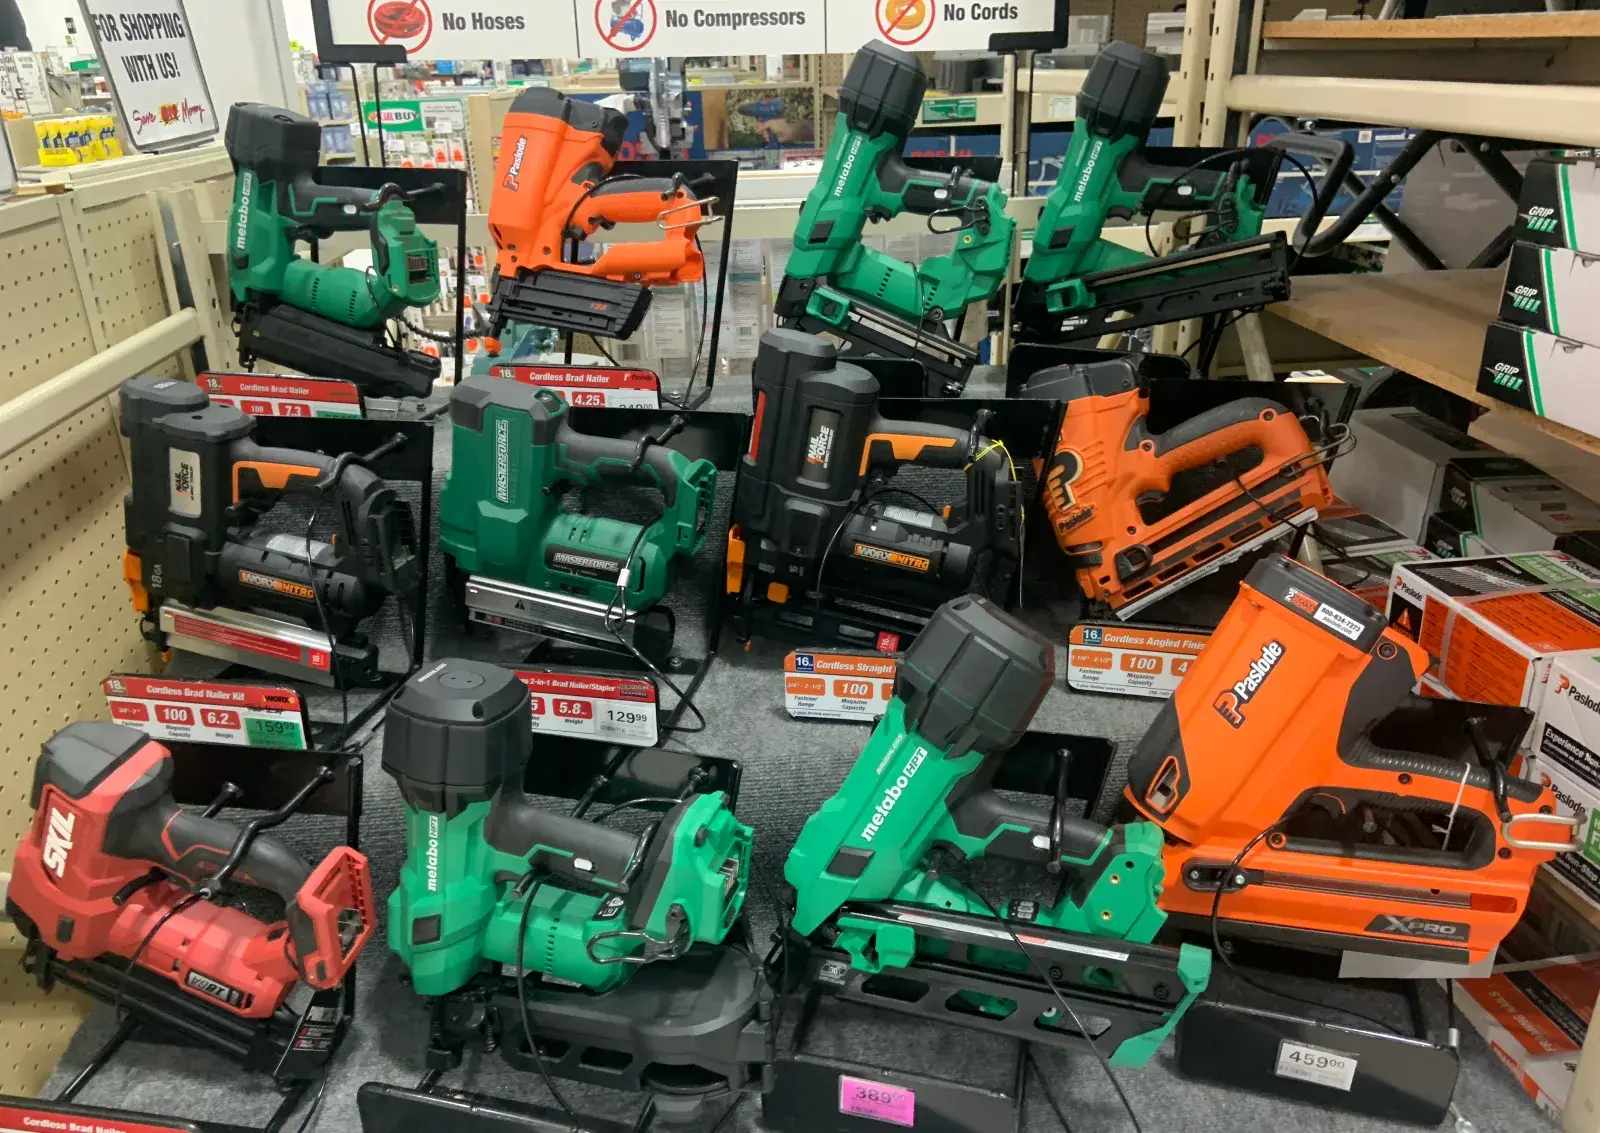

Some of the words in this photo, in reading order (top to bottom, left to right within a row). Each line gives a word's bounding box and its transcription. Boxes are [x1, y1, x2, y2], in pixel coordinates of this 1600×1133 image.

[666, 9, 688, 28] No
[694, 8, 805, 30] Compressors
[943, 4, 966, 21] No
[971, 2, 1018, 21] Cords
[91, 14, 122, 42] FOR
[119, 12, 186, 41] SHOPPING
[442, 12, 466, 30] No
[472, 12, 525, 31] Hoses
[121, 54, 159, 83] WITH
[155, 52, 181, 79] US!
[395, 111, 419, 121] BUY
[509, 137, 527, 176] Paslode
[242, 172, 252, 196] HPT
[834, 155, 855, 197] metabo
[1074, 160, 1095, 203] metabo
[1528, 206, 1555, 217] GRIP
[237, 196, 249, 250] metabo
[1514, 285, 1538, 297] GRIP
[1494, 362, 1520, 375] GRIP
[529, 371, 563, 381] Cordless
[565, 373, 584, 383] Brad
[586, 374, 610, 384] Nailer
[239, 383, 270, 393] Cordless
[271, 384, 288, 394] Brad
[288, 386, 310, 395] Nailer
[574, 394, 600, 407] 4.25
[285, 405, 301, 416] 7.3
[496, 419, 509, 503] MASTERFORCE
[860, 546, 890, 560] WORX
[553, 552, 619, 572] MASTERFORCE
[151, 564, 162, 588] 18GA
[243, 572, 277, 589] WORX
[1401, 581, 1423, 602] Paslode
[1104, 634, 1144, 645] Cordless
[1146, 637, 1180, 649] Angled
[1183, 640, 1206, 650] Finis
[816, 660, 855, 671] Cordless
[856, 663, 893, 674] Straight
[1129, 656, 1157, 670] 100
[1233, 641, 1282, 701] Paslode
[146, 685, 183, 696] Cordless
[184, 688, 204, 698] Brad
[206, 690, 230, 700] Nailer
[233, 691, 245, 701] Kit
[530, 678, 550, 687] 2-in-1
[552, 680, 568, 688] Brad
[569, 681, 616, 693] Nailer/Stapler
[842, 683, 868, 695] 100
[163, 708, 187, 721] 100
[559, 701, 581, 715] 5.8
[207, 712, 229, 725] 6.2
[166, 724, 191, 732] Magazine
[1545, 728, 1585, 758] Experience
[861, 776, 908, 842] metabo
[902, 746, 928, 778] HPT
[428, 815, 438, 838] HPT
[43, 807, 76, 878] SKIL
[427, 838, 438, 892] metabo
[23, 1116, 67, 1129] Cordless
[69, 1122, 93, 1133] Brad
